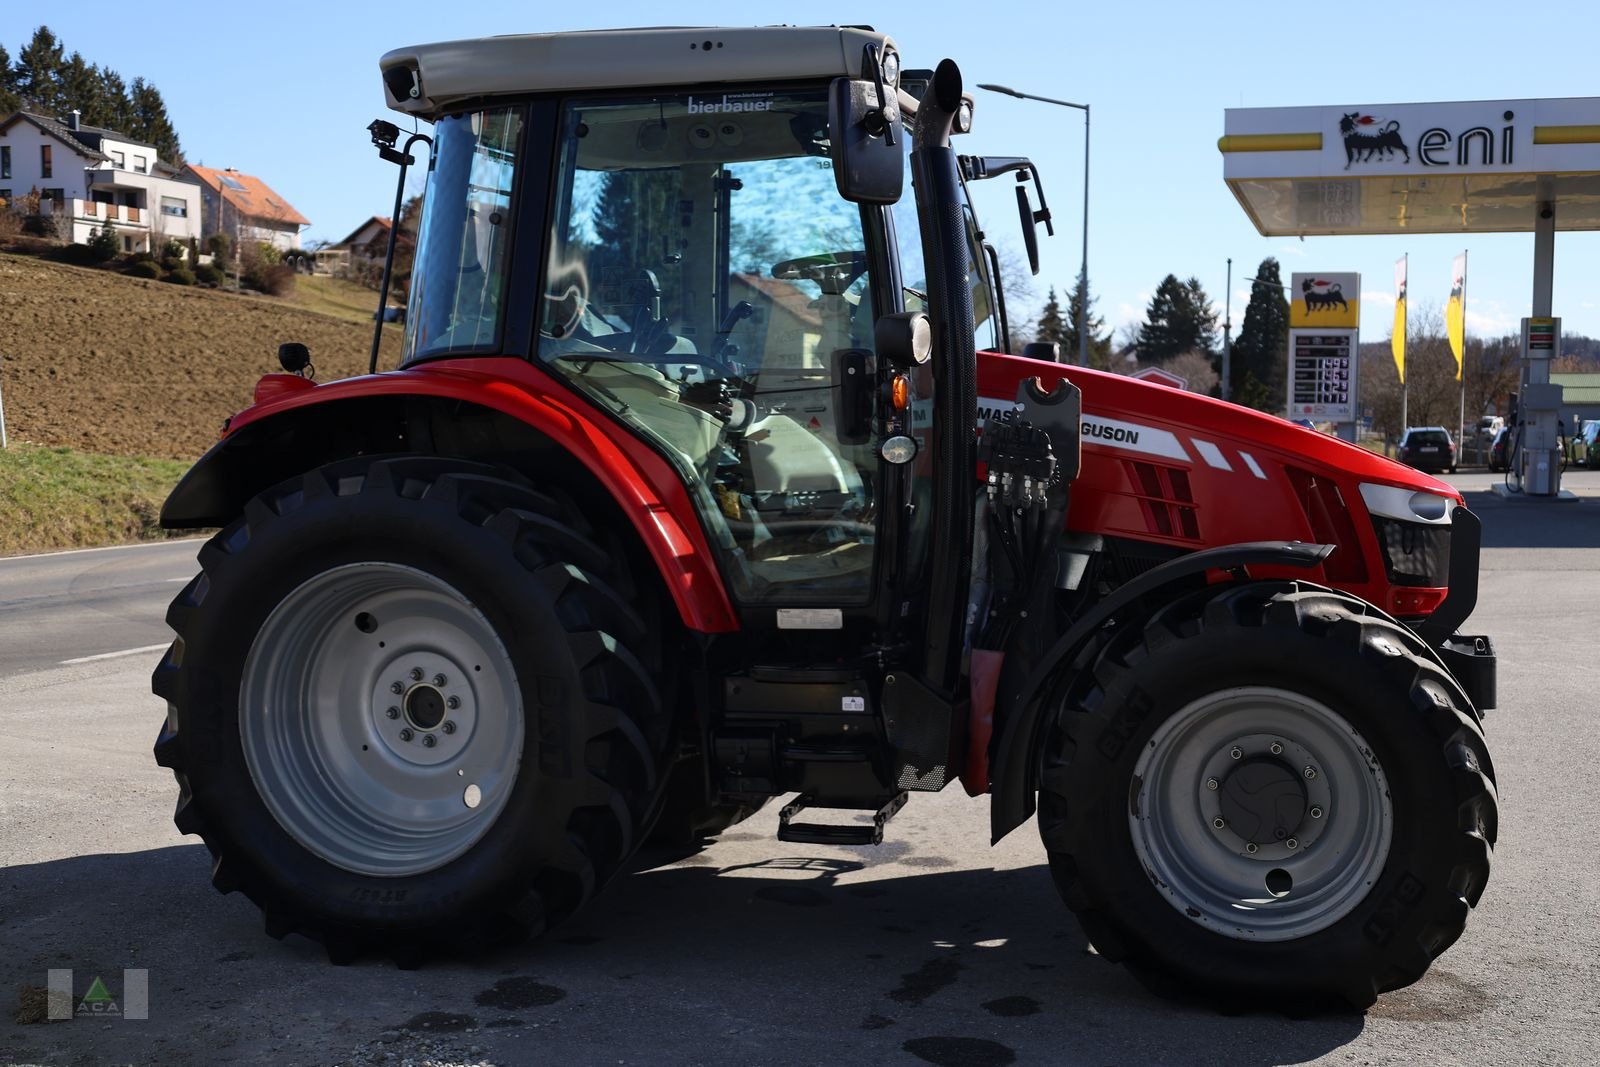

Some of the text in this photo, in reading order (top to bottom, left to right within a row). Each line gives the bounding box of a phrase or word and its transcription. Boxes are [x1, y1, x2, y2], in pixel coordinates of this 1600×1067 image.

[687, 95, 774, 114] bierbauer
[1418, 110, 1514, 166] eni
[977, 407, 1140, 445] MAS GUSON
[1098, 684, 1156, 761] BKT
[1364, 872, 1425, 946] BKT
